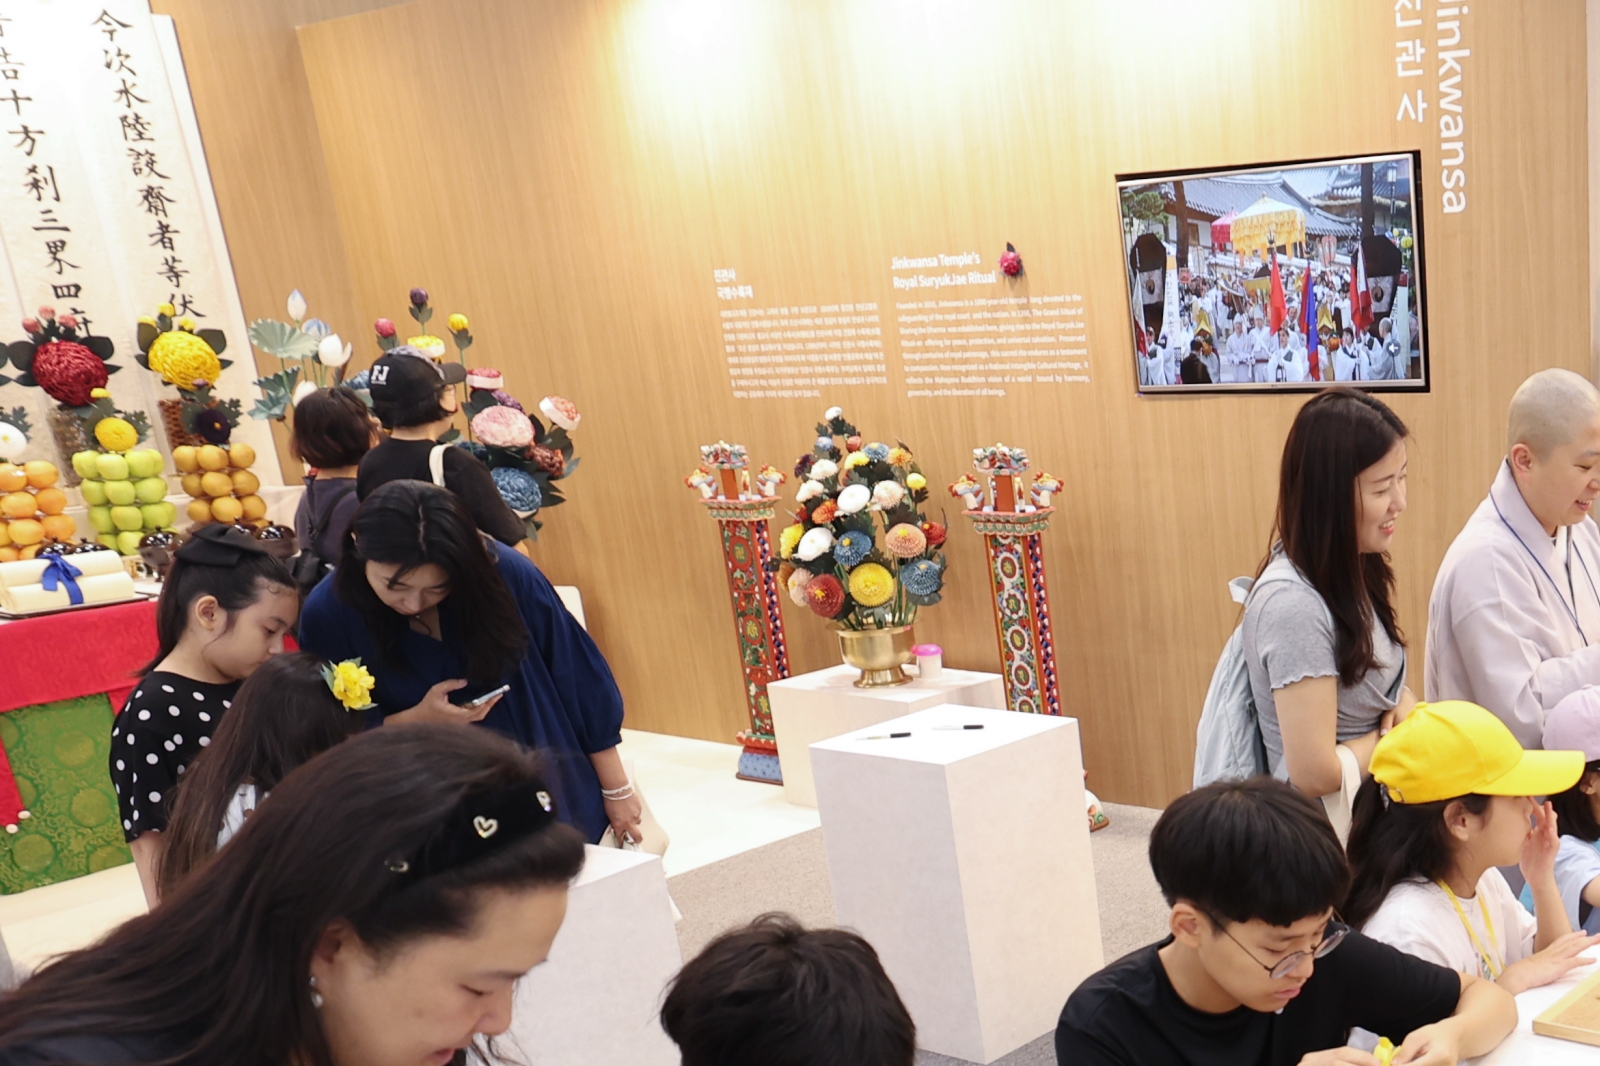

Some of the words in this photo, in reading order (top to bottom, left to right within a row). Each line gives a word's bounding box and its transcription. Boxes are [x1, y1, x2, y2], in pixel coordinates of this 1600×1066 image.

[1436, 0, 1471, 214] inkwansa
[0, 13, 92, 337] 告十方刹三界四
[891, 256, 938, 270] Jinkwansa
[938, 252, 980, 267] Temple's
[893, 275, 918, 290] Royal
[919, 274, 967, 288] SuryukJae
[967, 271, 996, 284] Ritual
